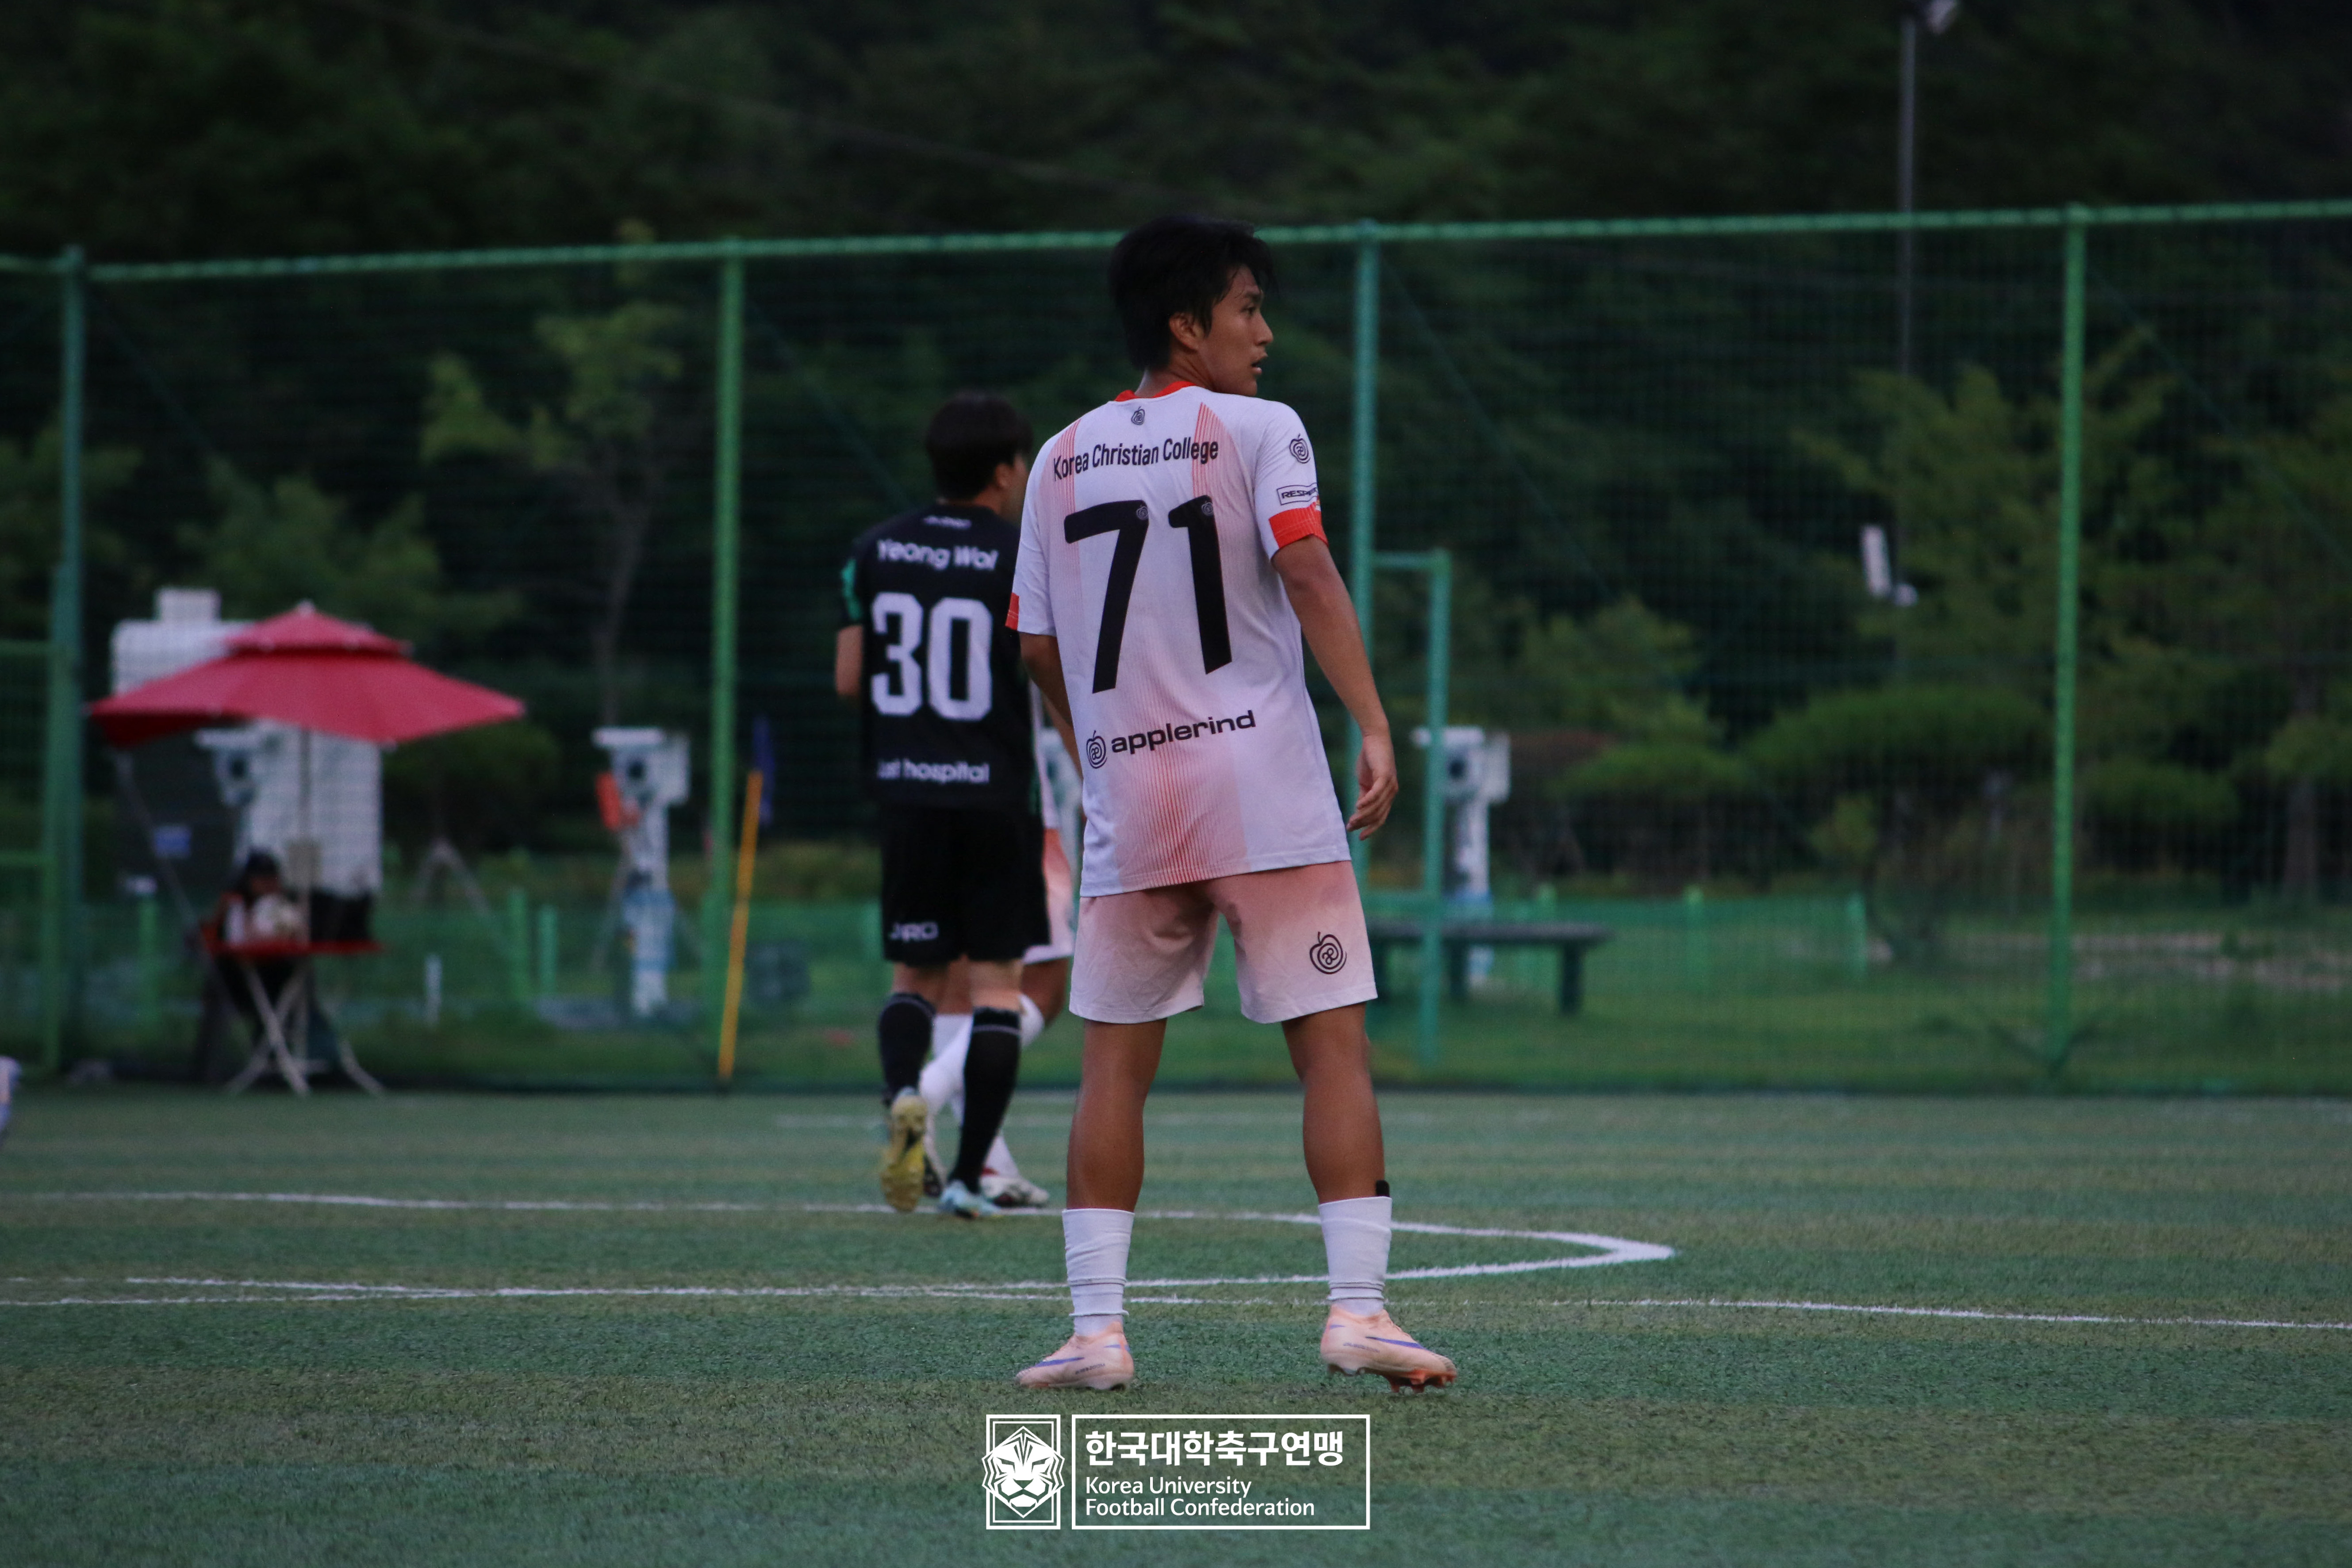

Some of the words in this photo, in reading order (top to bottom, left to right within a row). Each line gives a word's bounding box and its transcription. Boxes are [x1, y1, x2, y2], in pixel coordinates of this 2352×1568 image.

[1054, 452, 1089, 481] Korea
[1092, 443, 1159, 468] Christian
[1163, 437, 1218, 464] College
[877, 538, 951, 571] Yeong
[1063, 495, 1232, 694] 71
[871, 592, 992, 721] 30
[1111, 709, 1256, 755] applerind
[902, 758, 990, 785] hospital
